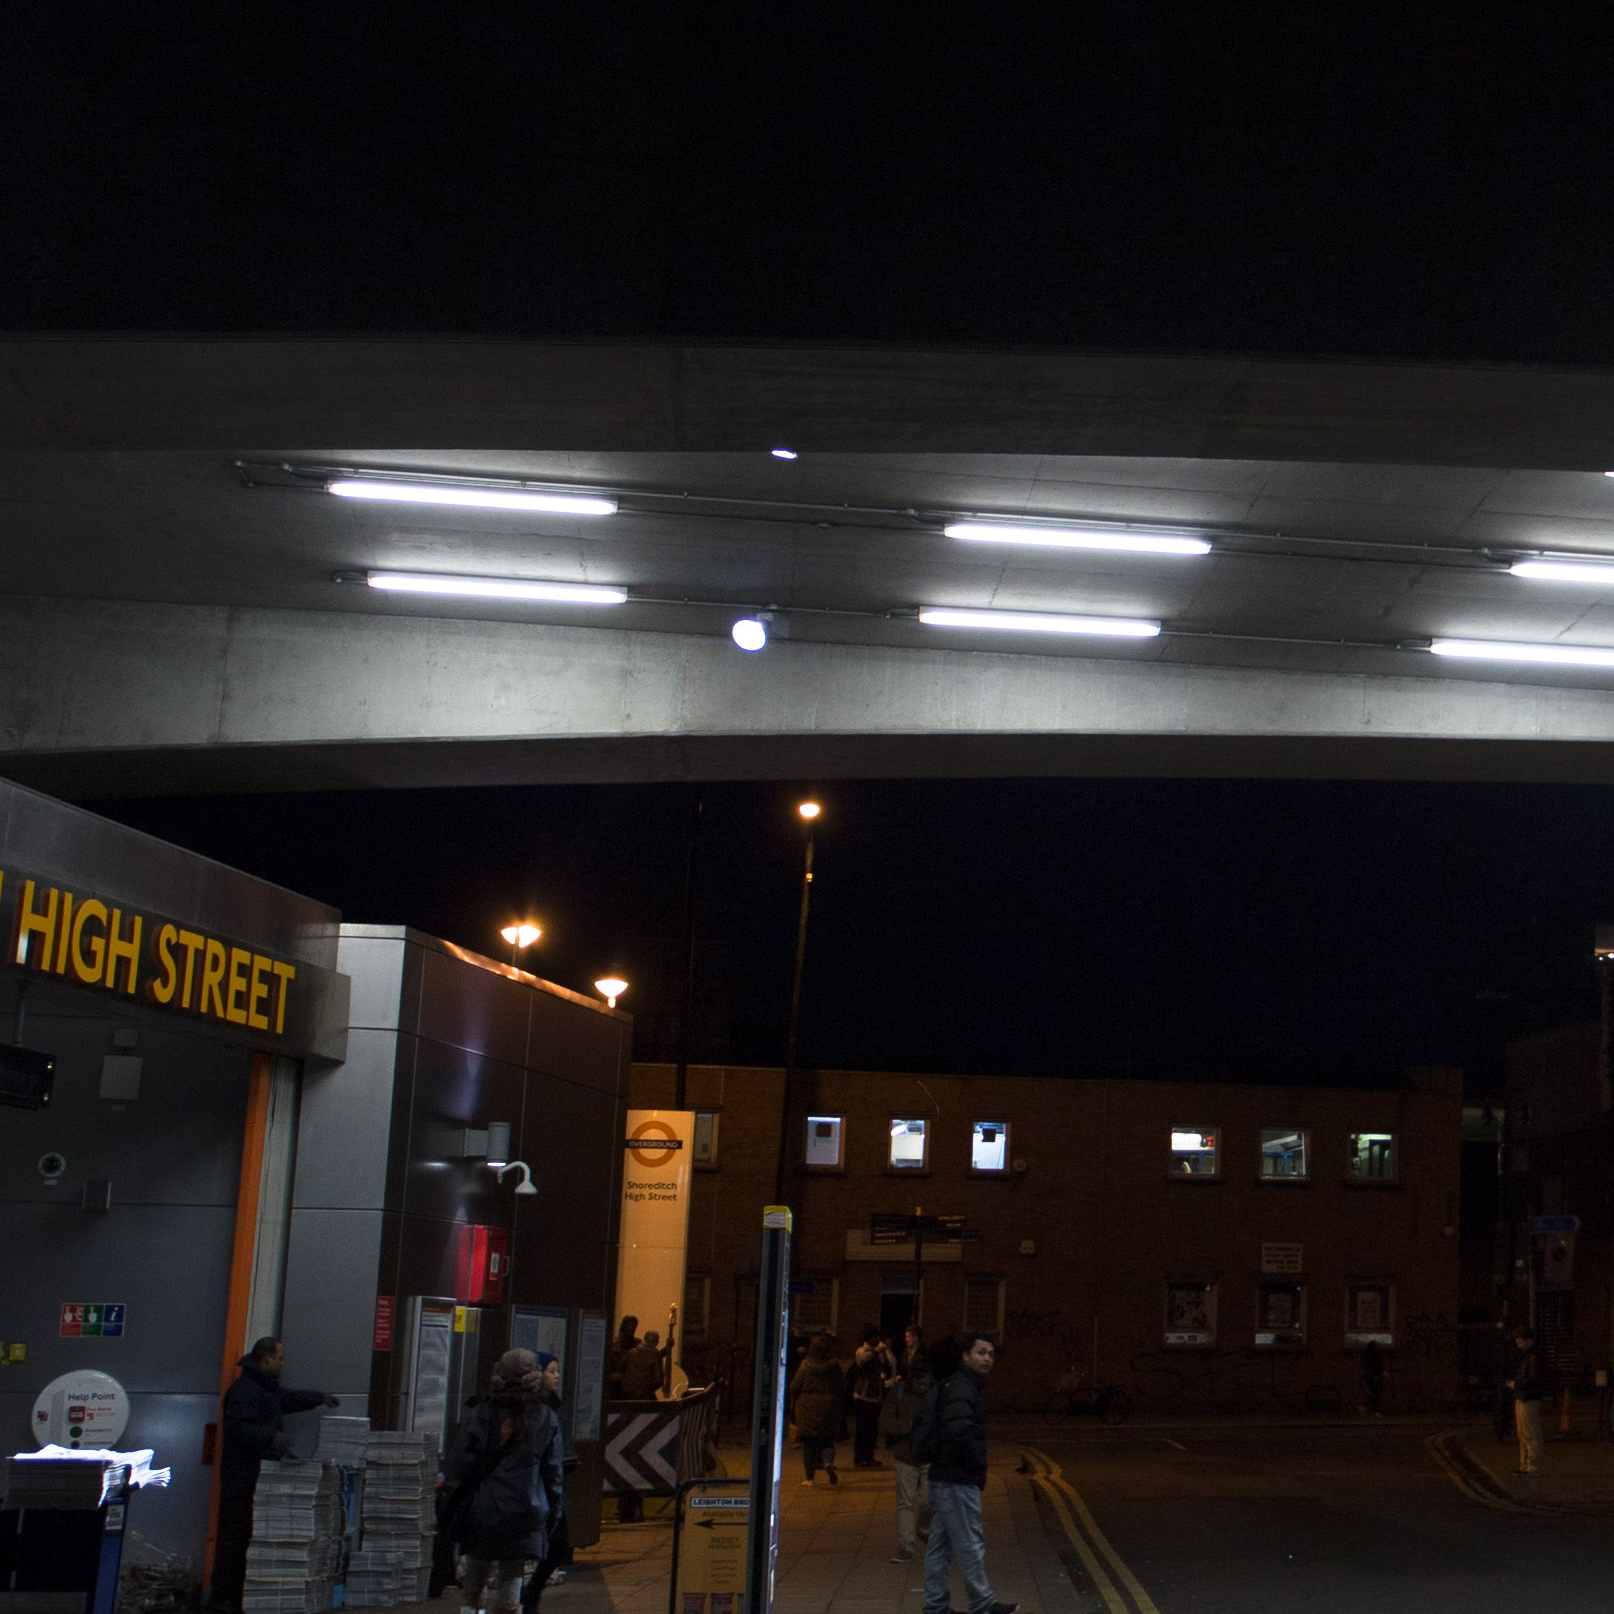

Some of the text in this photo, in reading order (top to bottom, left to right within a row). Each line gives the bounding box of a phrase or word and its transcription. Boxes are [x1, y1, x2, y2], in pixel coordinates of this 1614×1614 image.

[16, 879, 296, 1035] HIGH STREET
[629, 1140, 679, 1148] OVERGROUND
[627, 1180, 677, 1190] Shoreditch
[625, 1192, 677, 1202] High Street
[68, 1392, 116, 1402] Help Point
